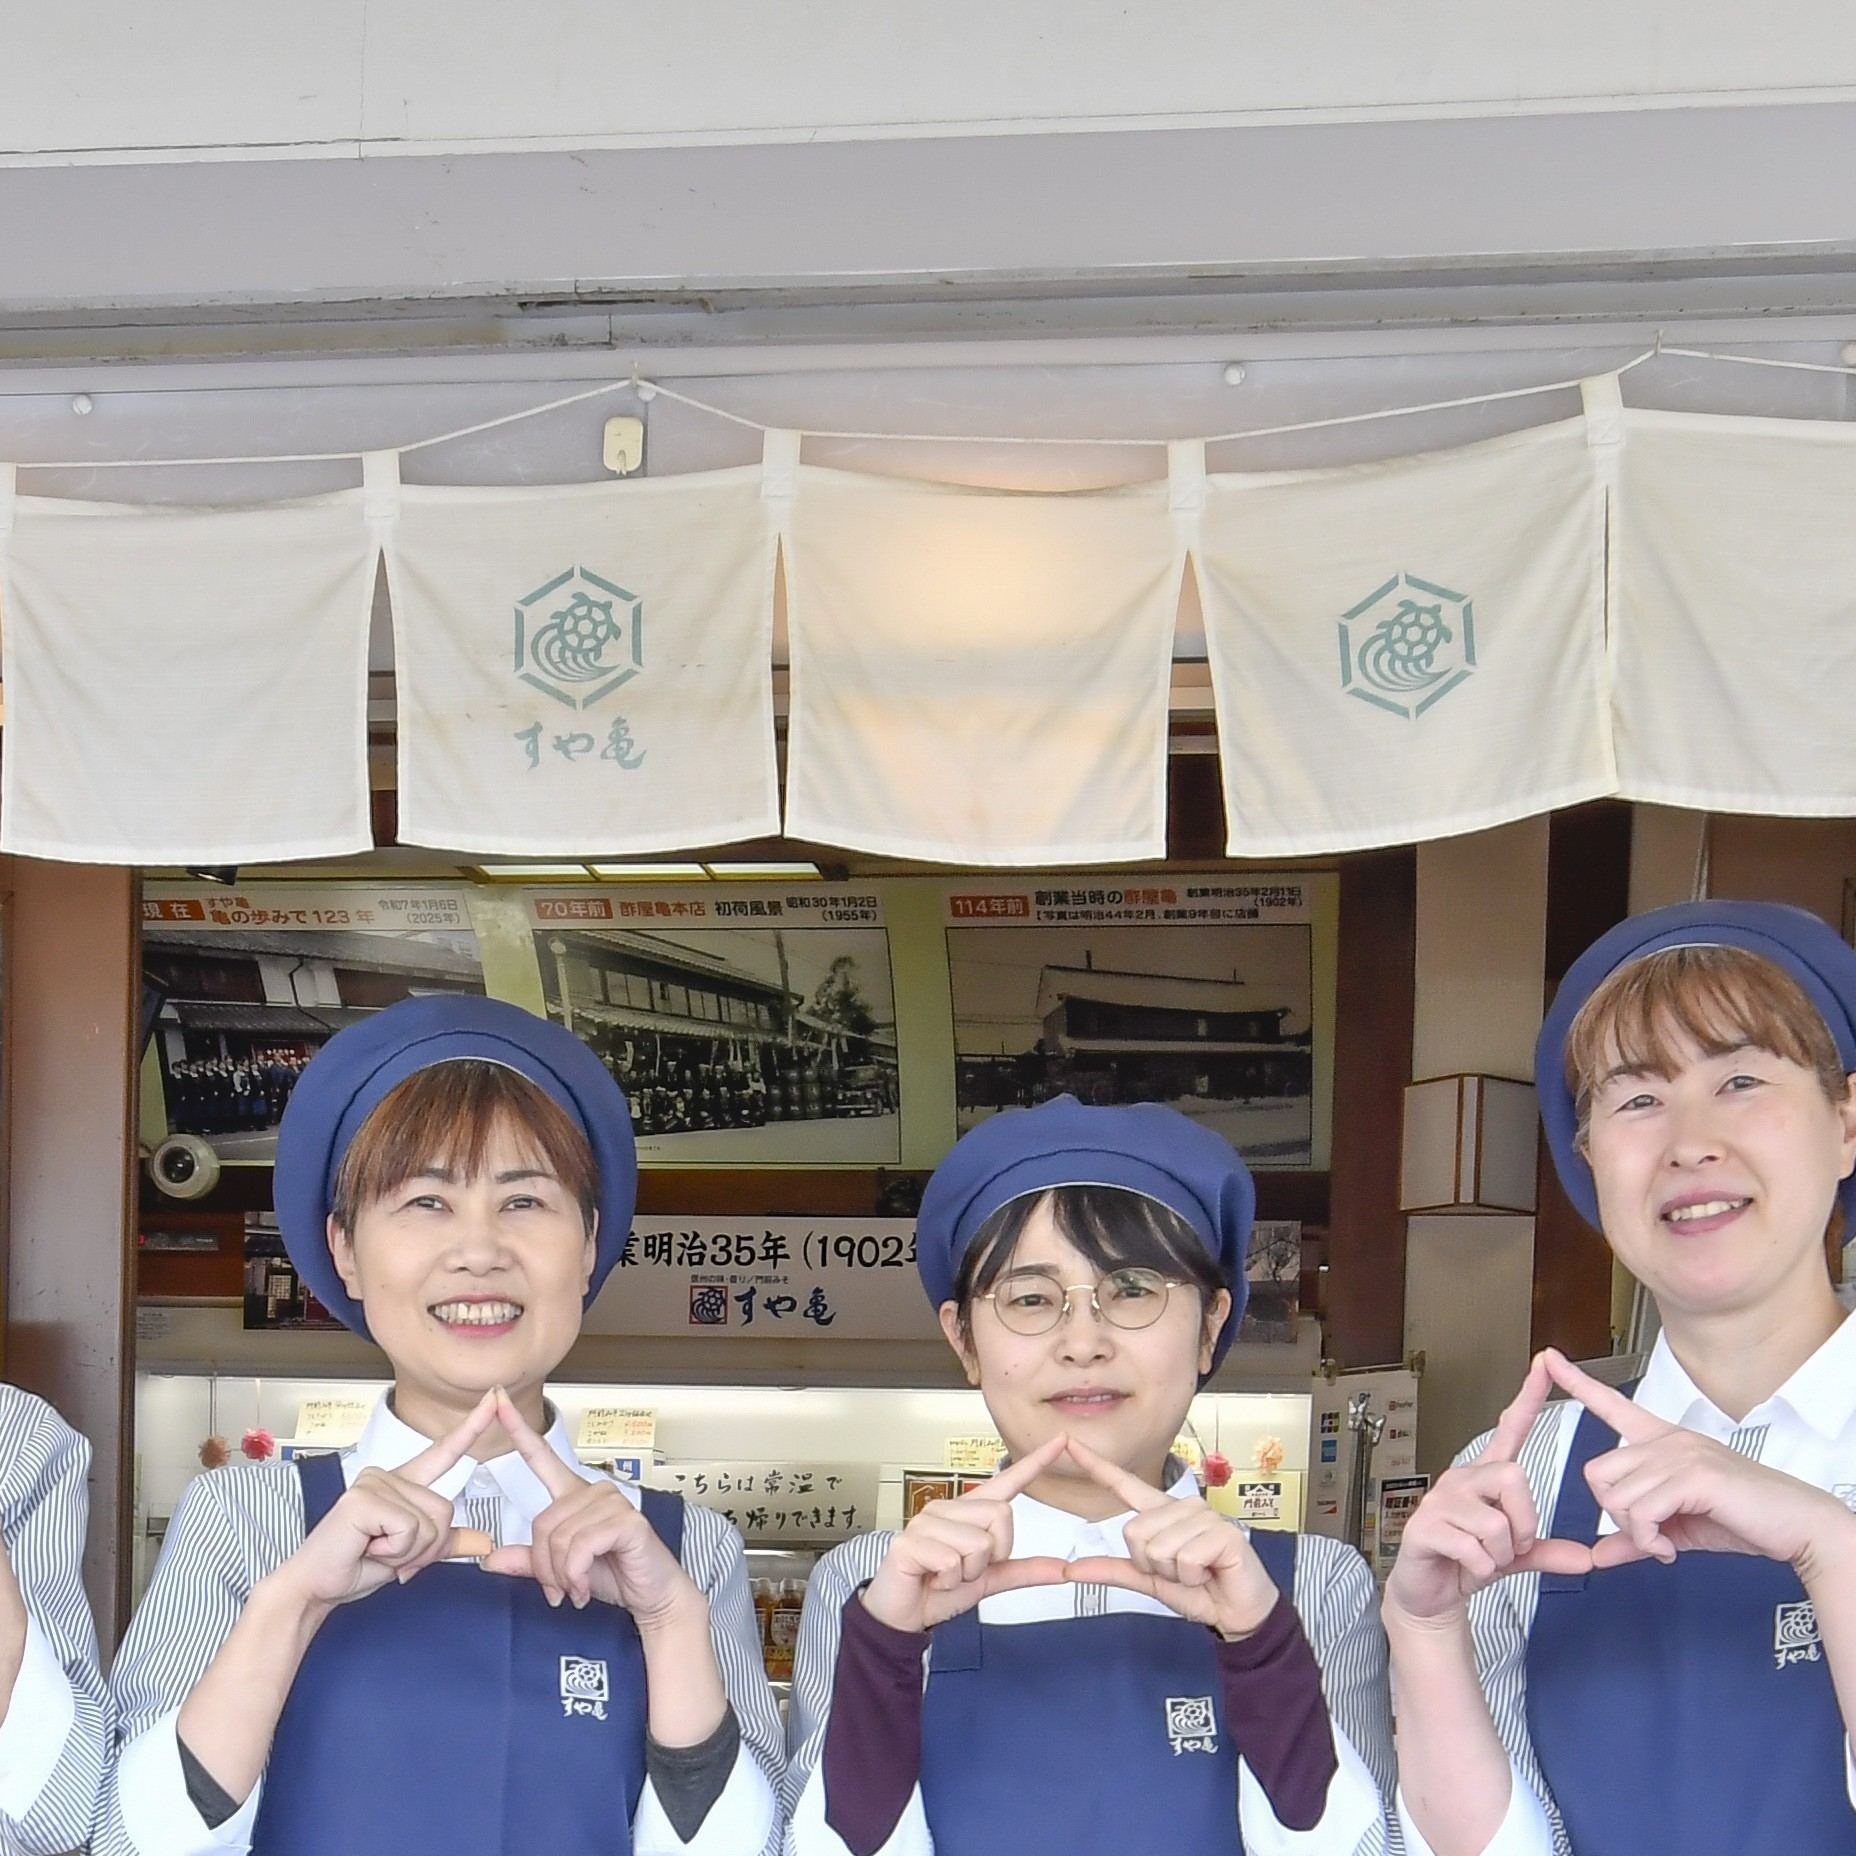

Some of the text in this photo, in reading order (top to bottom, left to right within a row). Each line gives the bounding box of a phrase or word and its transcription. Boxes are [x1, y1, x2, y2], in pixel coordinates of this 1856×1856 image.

[513, 715, 648, 771] すや亀
[541, 901, 607, 918] 70年前
[715, 900, 784, 917] 初荷風景
[954, 897, 1026, 915] 114年前
[734, 1285, 837, 1327] すや亀
